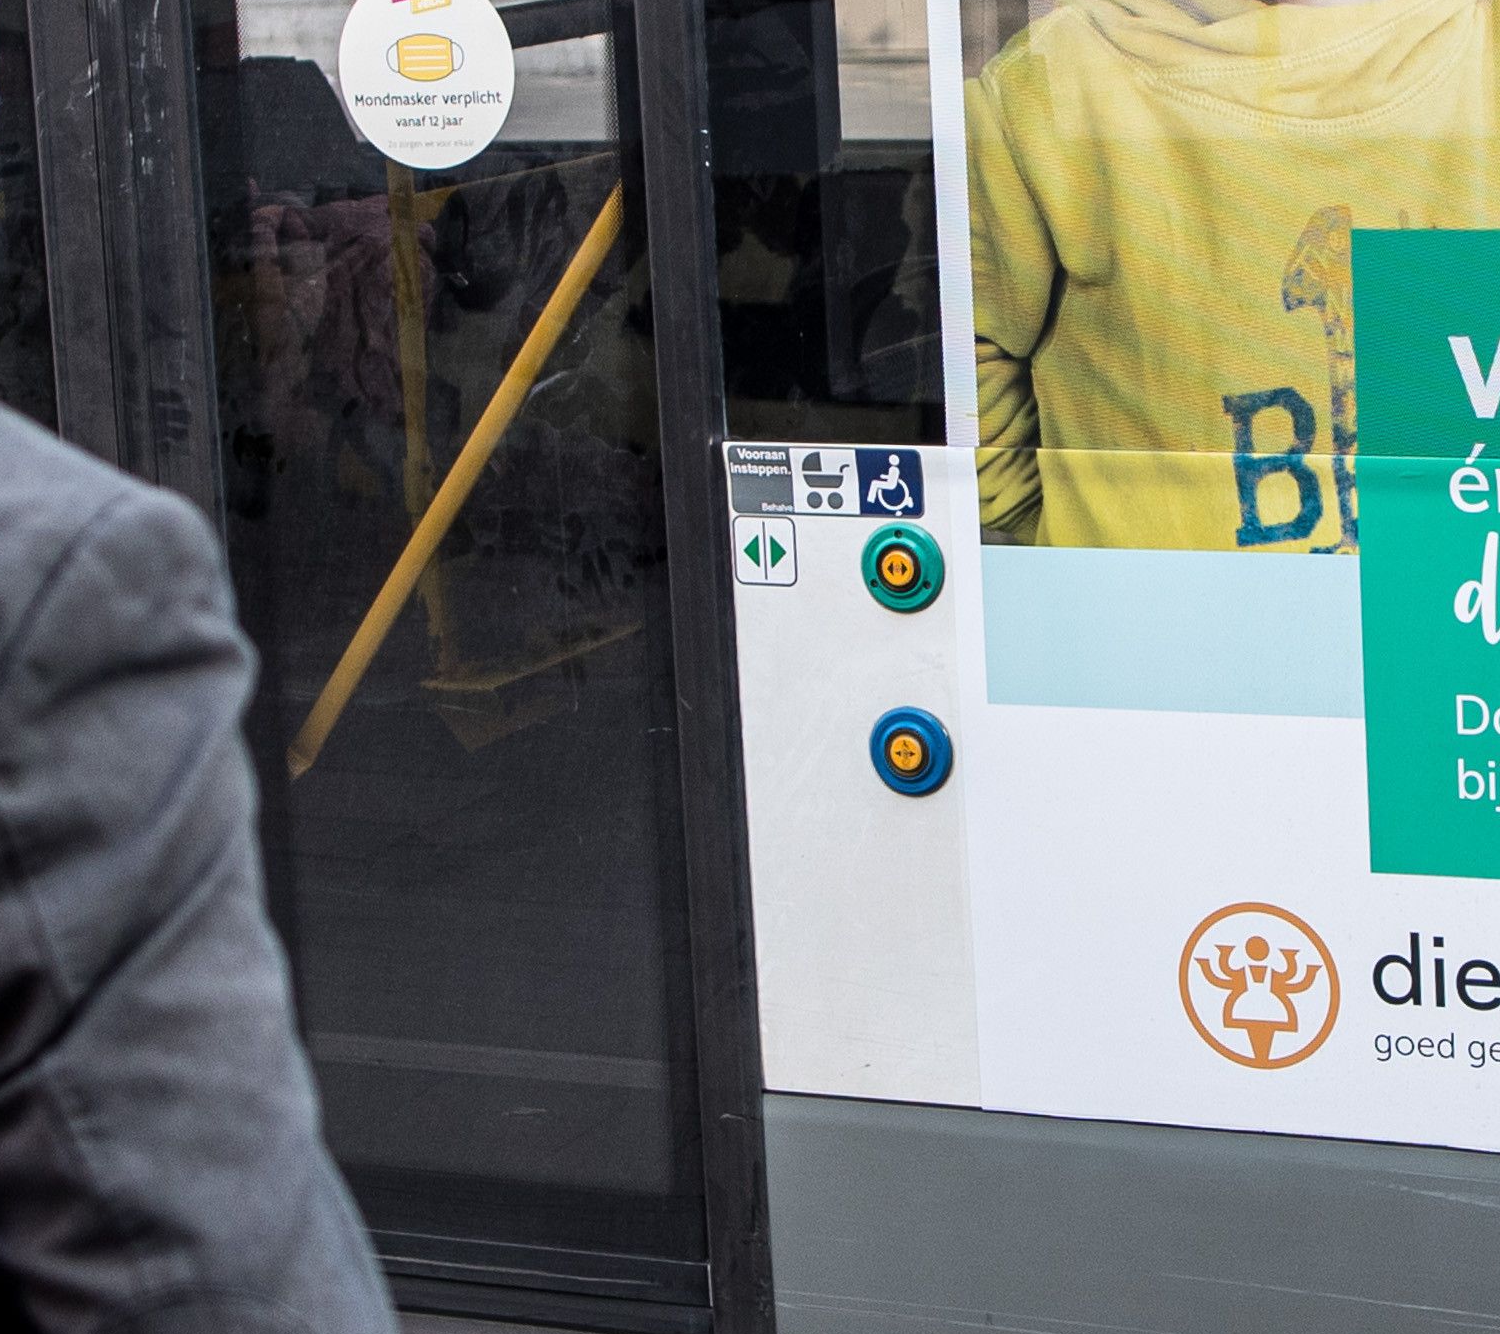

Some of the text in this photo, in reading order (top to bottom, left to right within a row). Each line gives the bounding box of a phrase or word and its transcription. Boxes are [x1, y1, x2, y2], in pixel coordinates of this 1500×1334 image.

[355, 90, 503, 108] Mondmasker verplicht
[396, 115, 464, 129] vanaf 12 jaar
[737, 448, 786, 460] Vooraan
[1375, 1033, 1454, 1061] goed
